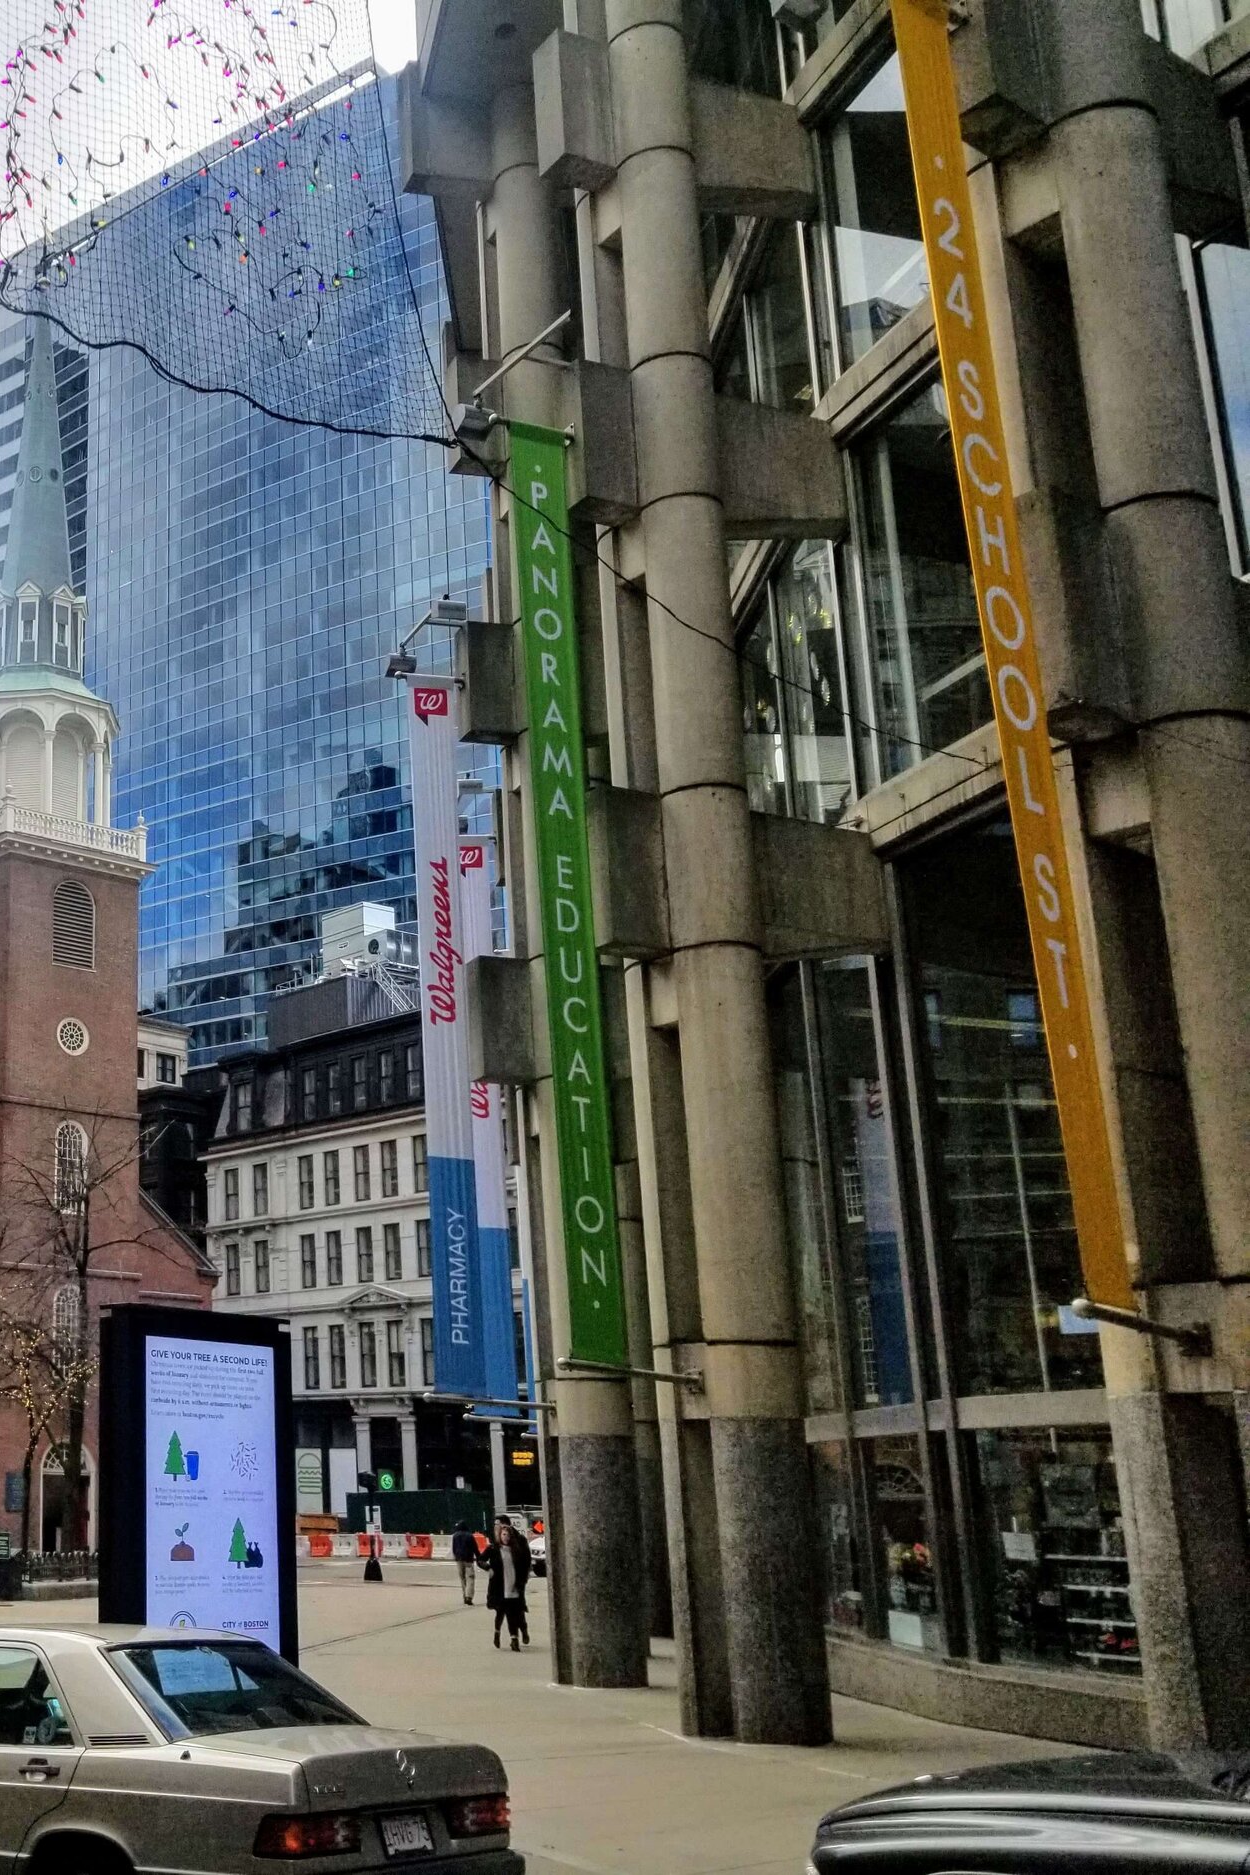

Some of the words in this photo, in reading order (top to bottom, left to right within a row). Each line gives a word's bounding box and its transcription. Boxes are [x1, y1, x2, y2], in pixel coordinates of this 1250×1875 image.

[934, 198, 972, 328] 24
[959, 360, 1045, 816] SCHOOL
[1034, 853, 1069, 1010] ST
[427, 856, 463, 1026] Walgreens
[530, 481, 573, 820] PANORAMA
[556, 855, 607, 1286] EDUCATION
[447, 1207, 470, 1345] PHARMACY
[150, 1350, 168, 1359] GIVE
[170, 1351, 191, 1360] YOUR
[193, 1353, 211, 1362] TREE
[212, 1355, 219, 1363] A
[219, 1355, 250, 1366] SECOND
[251, 1358, 268, 1367] LIFE!
[243, 1620, 269, 1628] BOSTON
